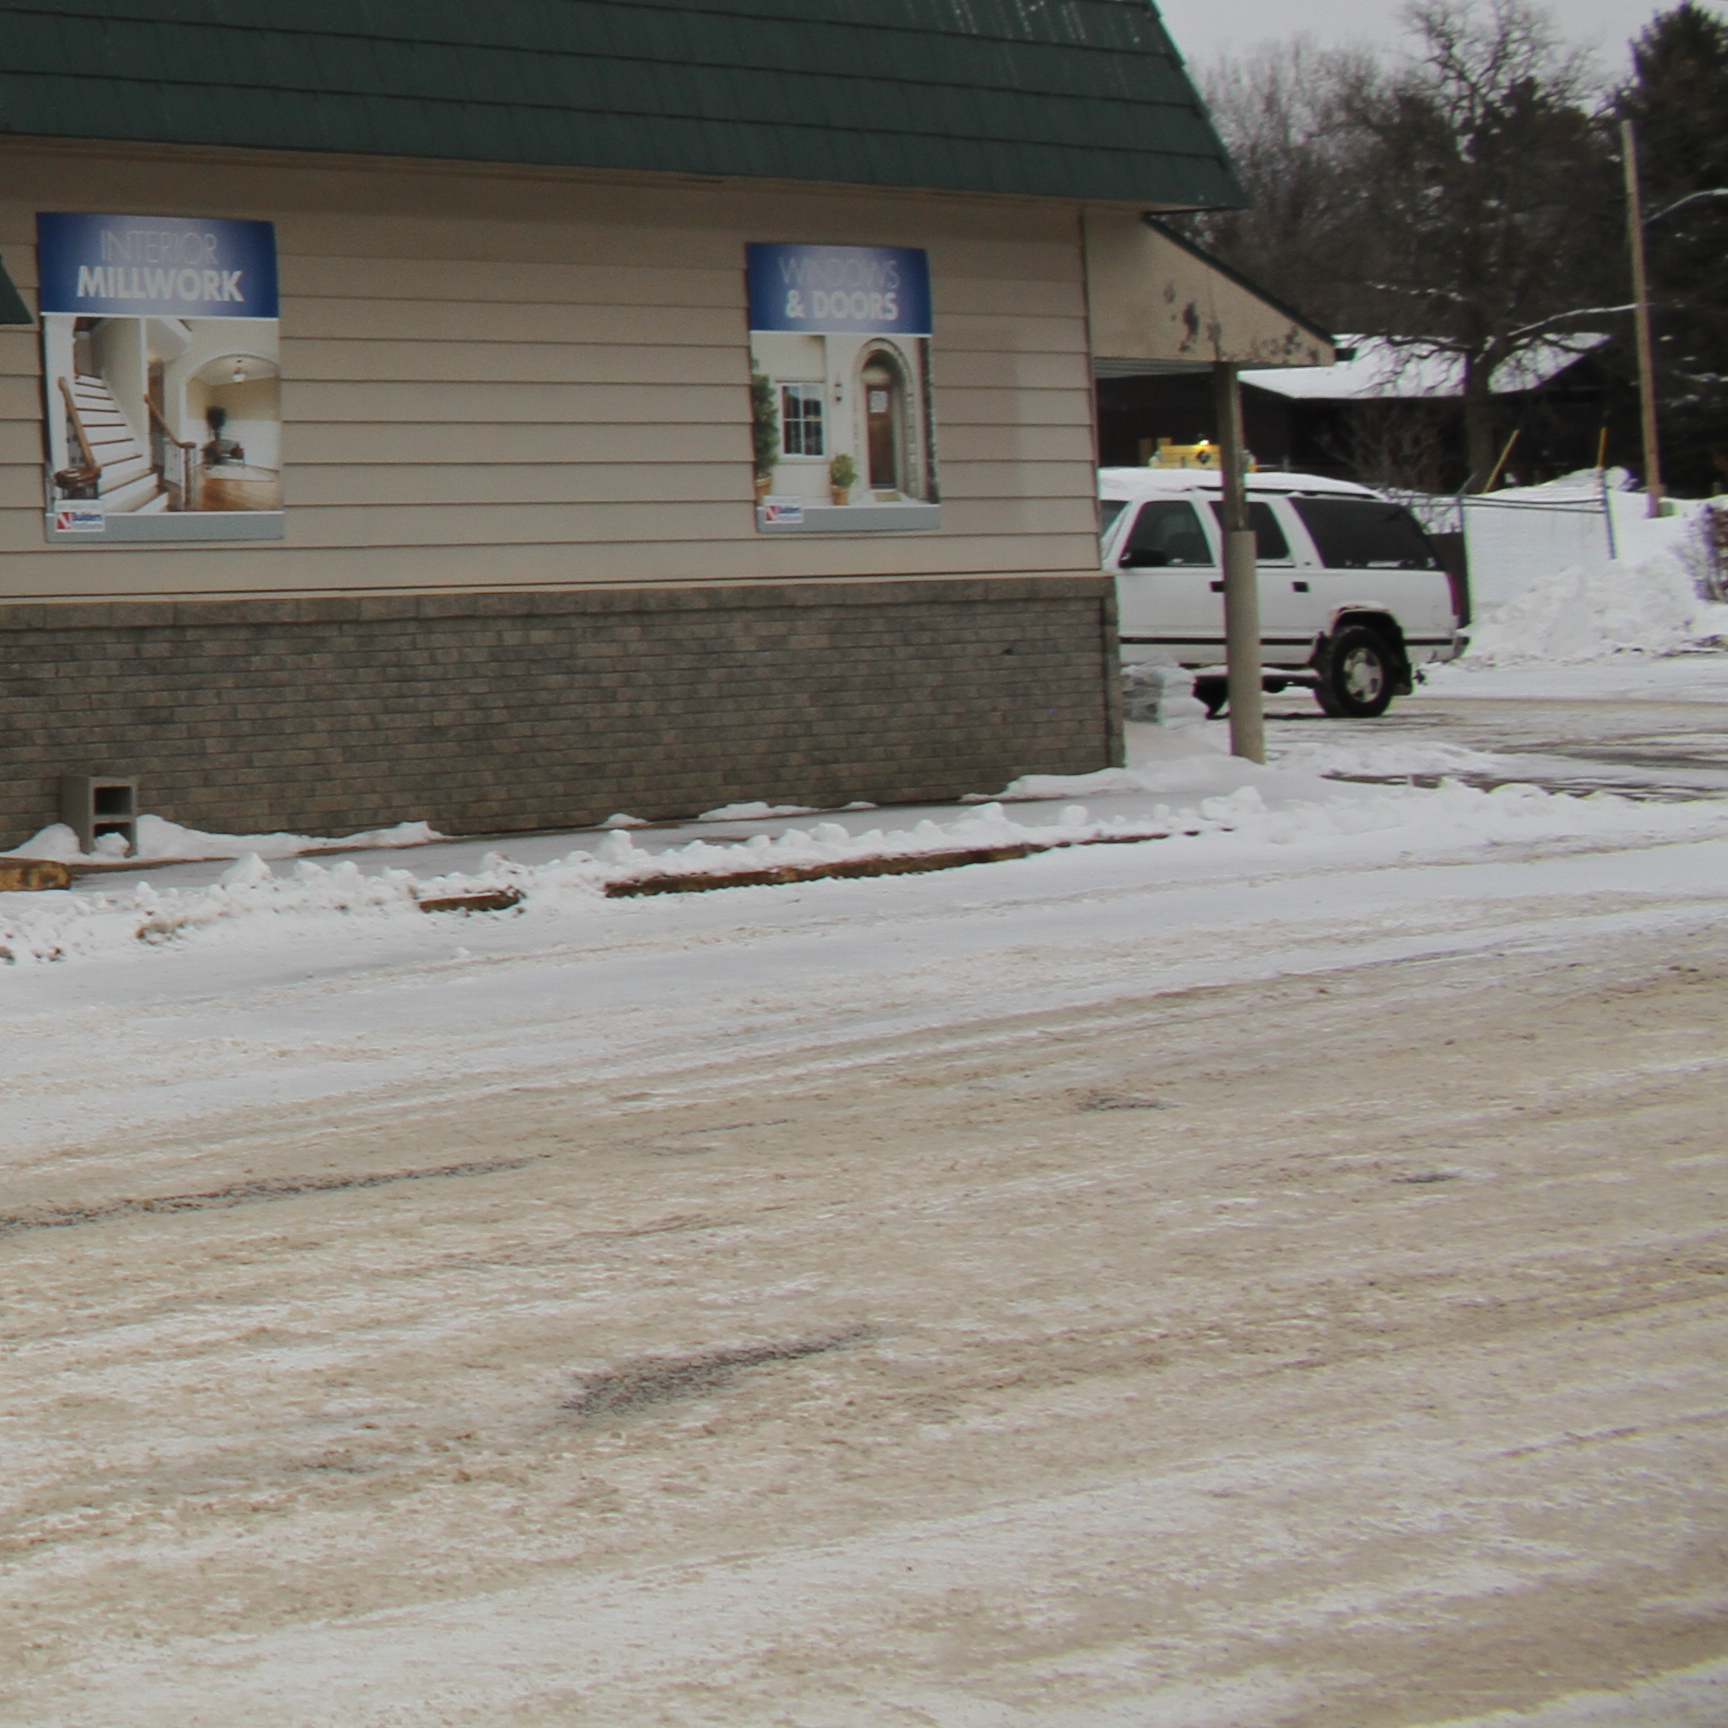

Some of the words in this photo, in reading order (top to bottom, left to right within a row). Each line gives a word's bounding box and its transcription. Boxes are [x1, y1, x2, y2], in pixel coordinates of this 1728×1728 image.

[100, 229, 219, 265] INTERIOR
[76, 264, 244, 303] MILLWORK
[785, 289, 807, 318] &
[812, 289, 899, 320] DOORS
